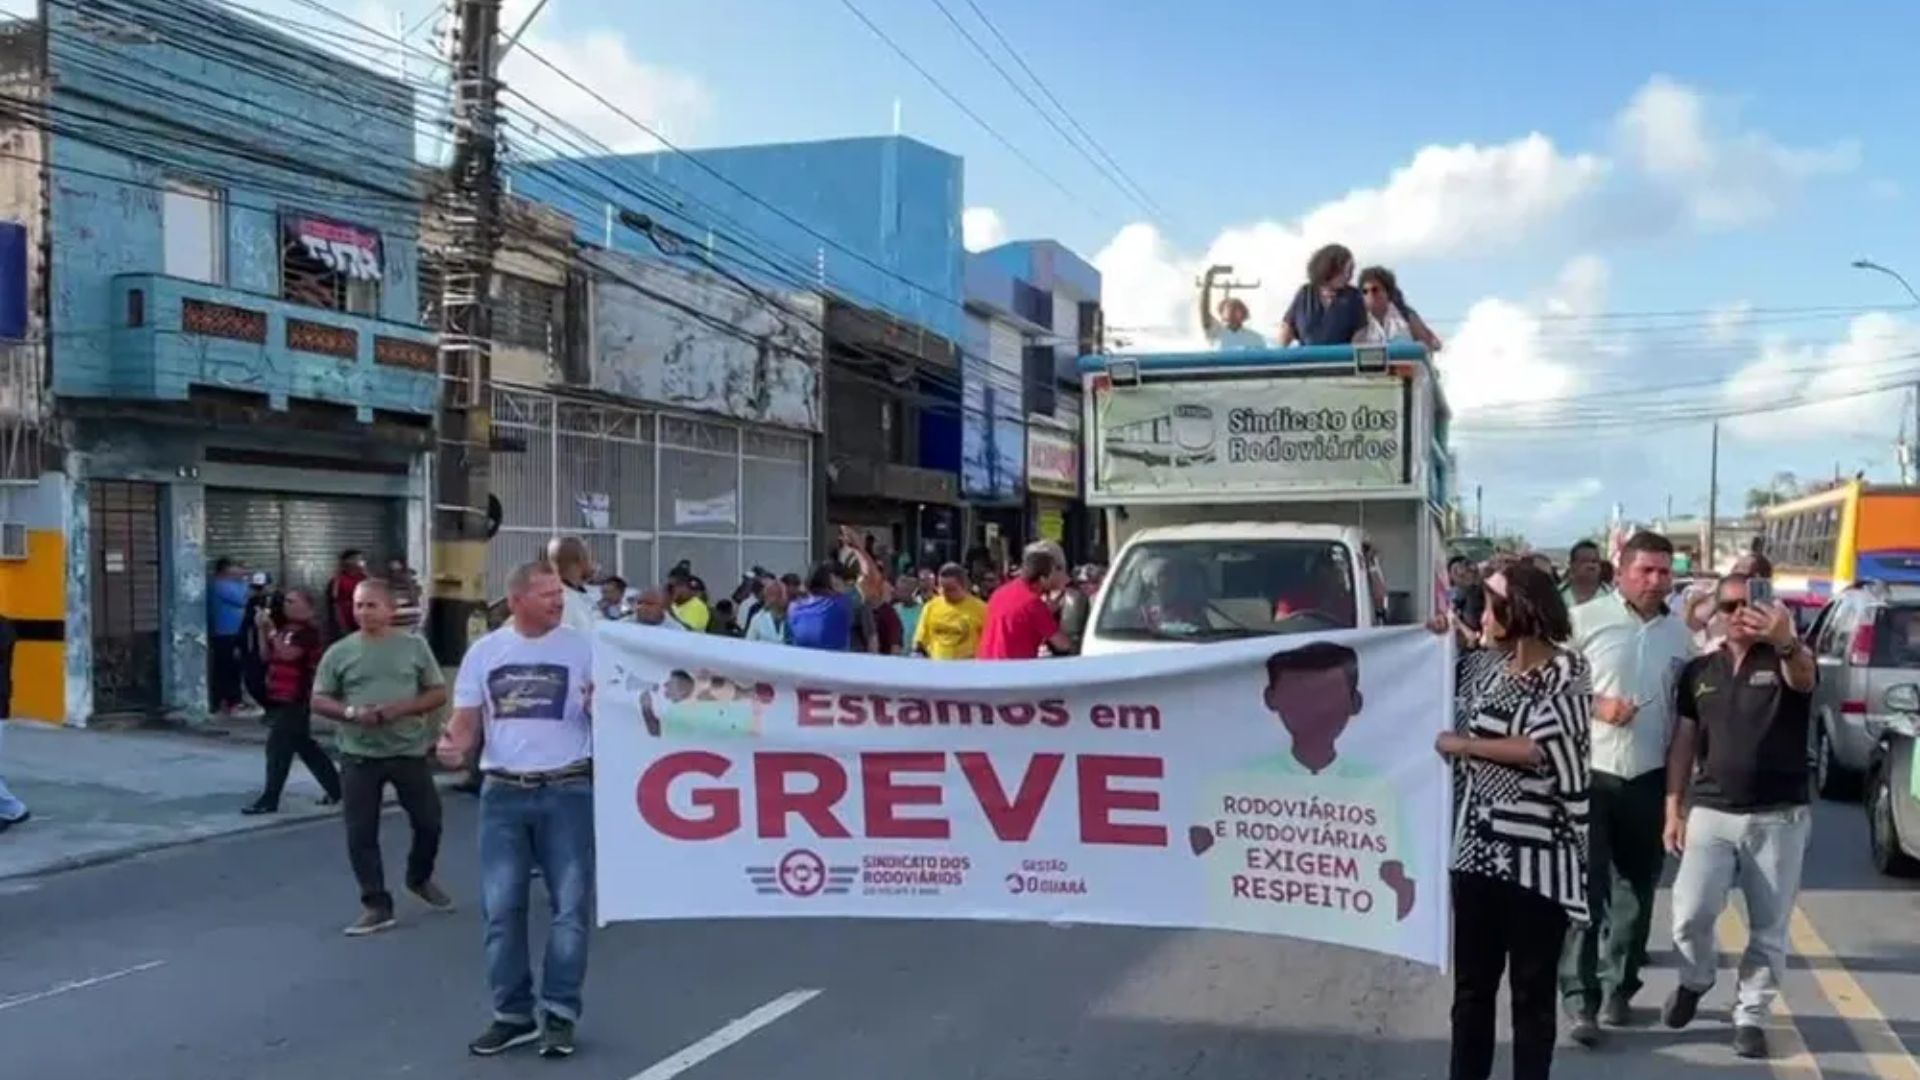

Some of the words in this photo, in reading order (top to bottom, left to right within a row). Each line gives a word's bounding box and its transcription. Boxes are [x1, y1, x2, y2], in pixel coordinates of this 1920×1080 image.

[1228, 407, 1346, 434] Sindicato
[1352, 405, 1397, 431] dos
[1228, 434, 1398, 463] Rodoviários
[796, 687, 1070, 728] Estamos
[1089, 702, 1161, 731] em
[636, 750, 1168, 847] GREVE
[1223, 795, 1377, 826] RODOVIÁRIOS
[1215, 820, 1227, 837] E
[1236, 821, 1387, 853] RODOVIÁRIAS
[863, 855, 938, 868] SINDICATO
[940, 856, 970, 869] DOS
[863, 871, 962, 885] RODOVIÁRIOS
[1247, 847, 1359, 882] EXIGEM
[1232, 874, 1373, 912] RESPEITO
